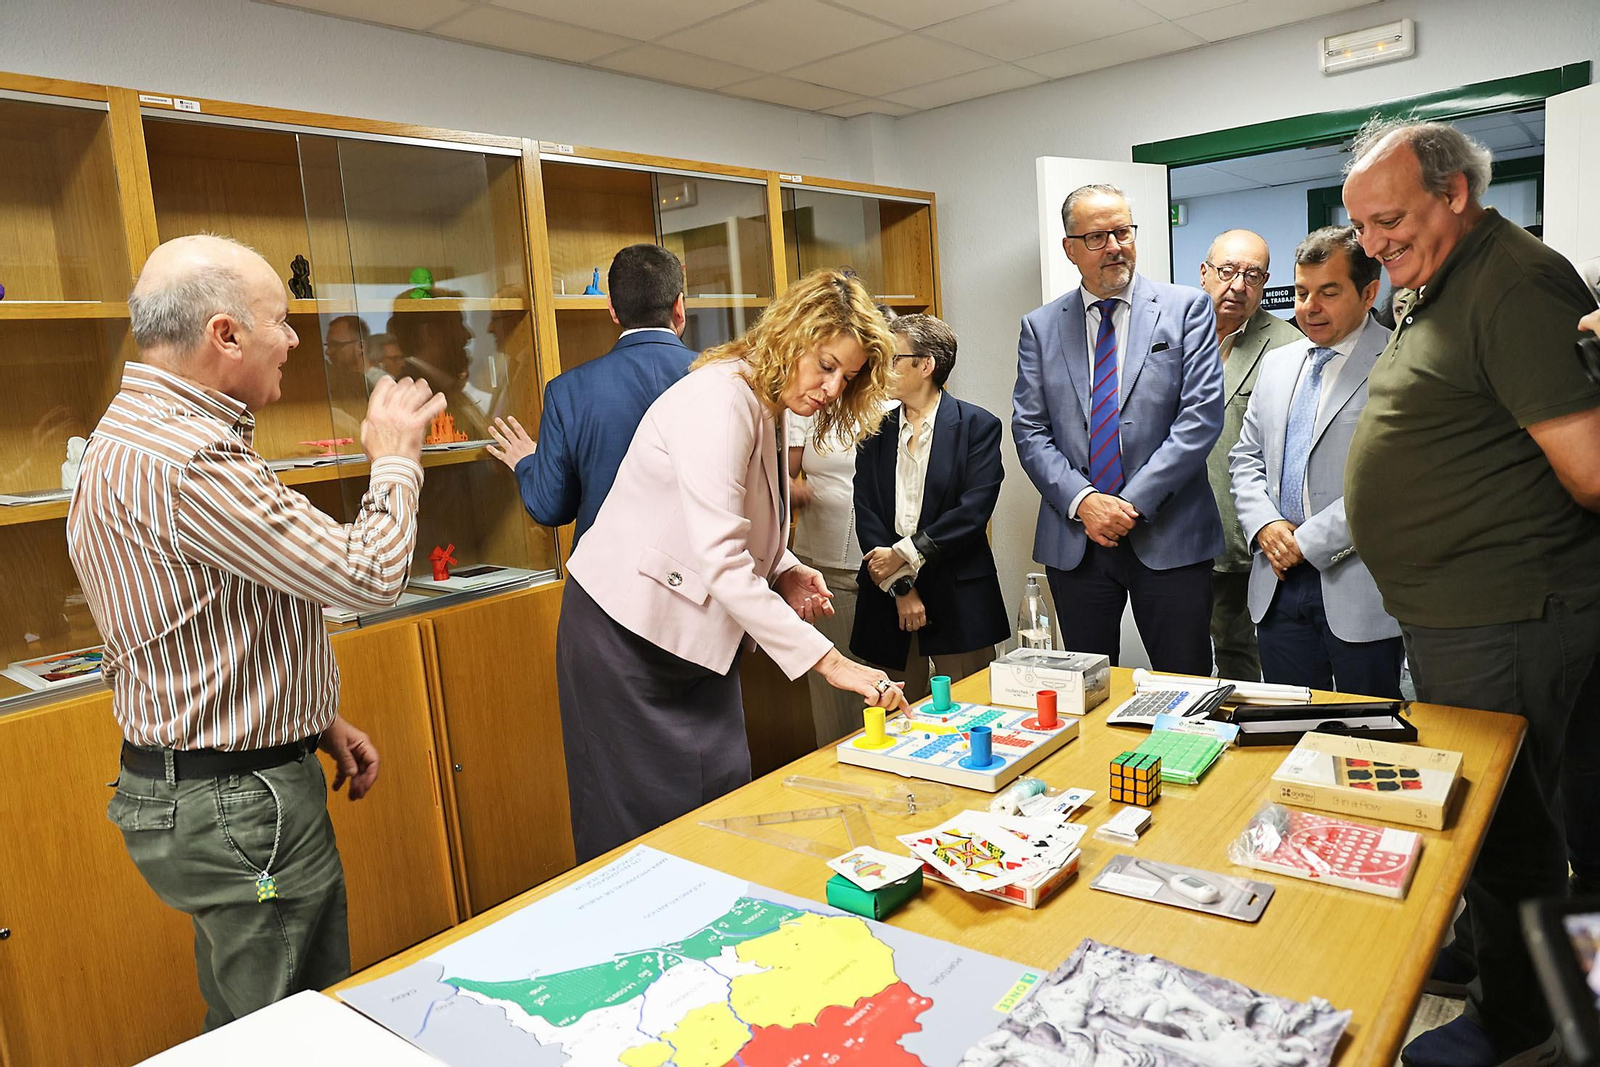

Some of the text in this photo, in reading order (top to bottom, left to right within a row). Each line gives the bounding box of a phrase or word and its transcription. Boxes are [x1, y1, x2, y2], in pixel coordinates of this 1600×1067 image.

[1265, 289, 1289, 297] MÉDICO
[928, 957, 963, 987] PORTUGAL
[999, 985, 1026, 1010] ONCE
